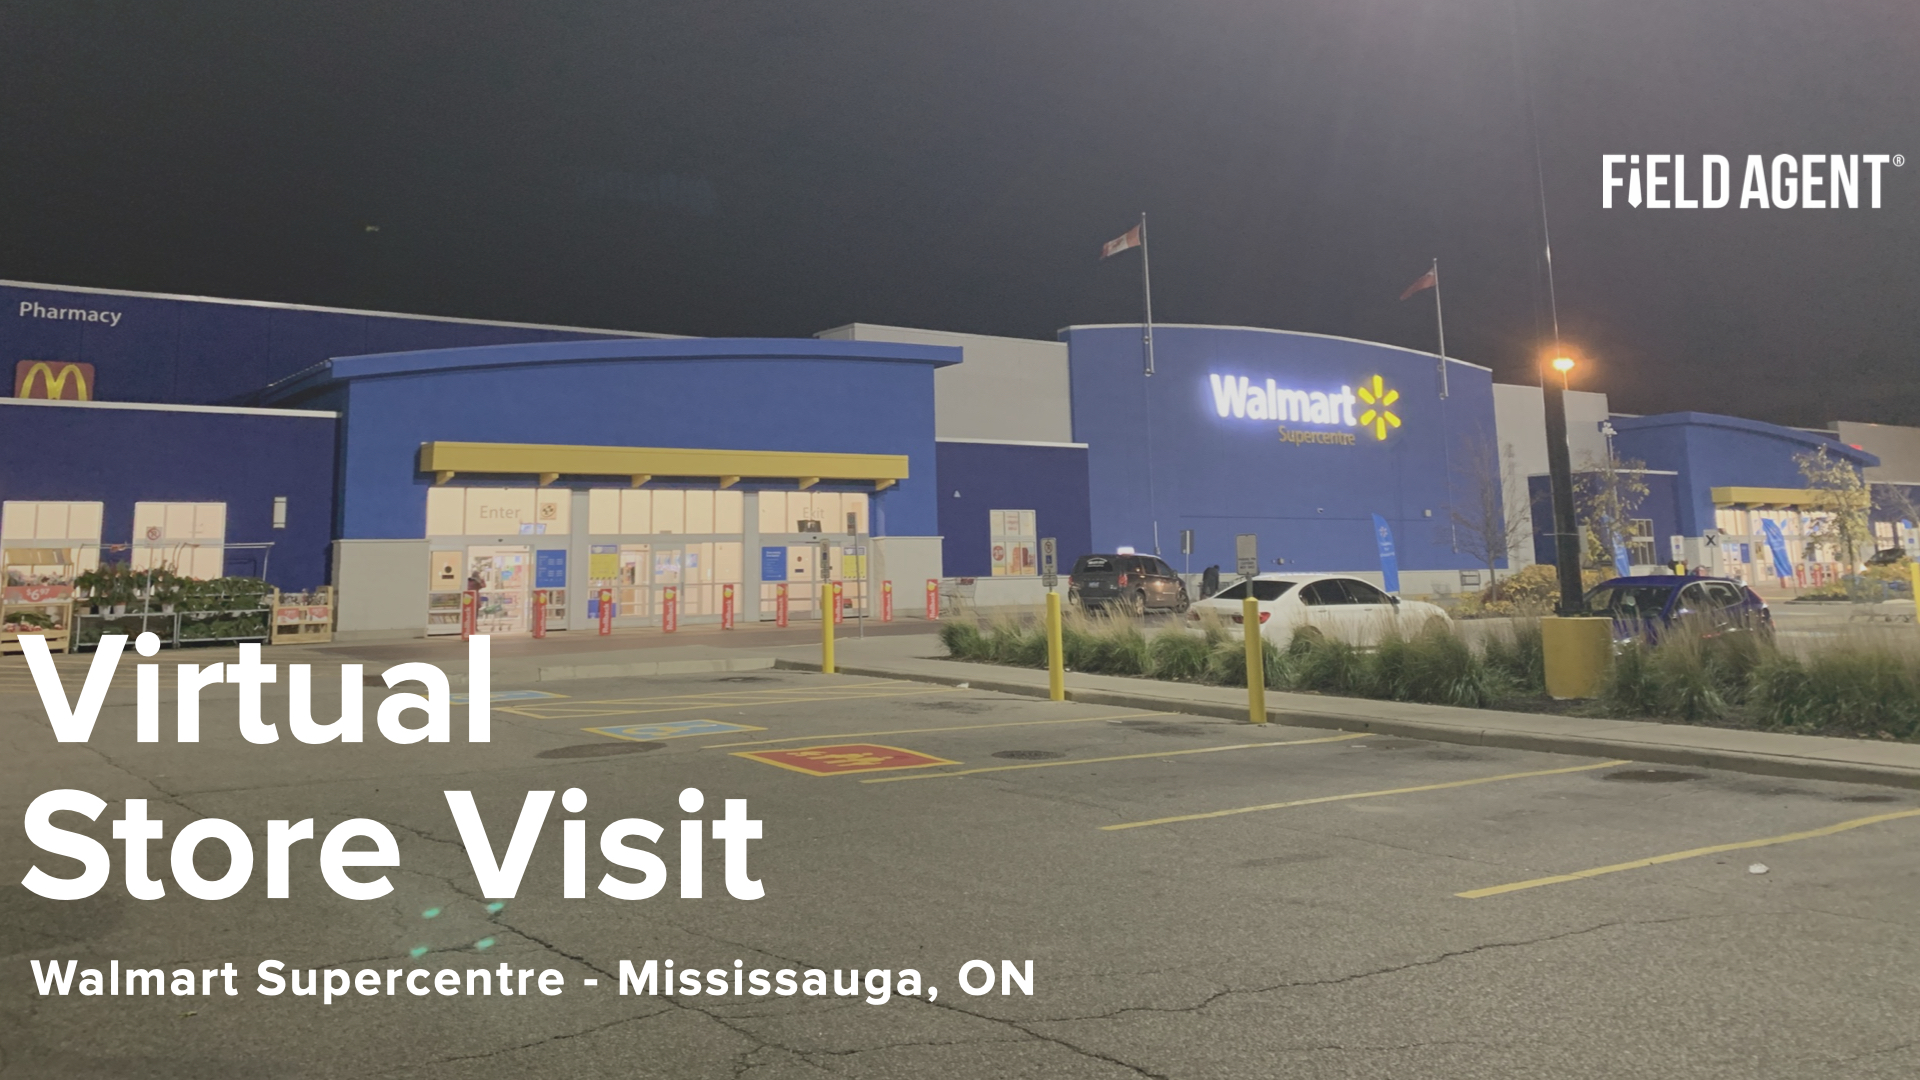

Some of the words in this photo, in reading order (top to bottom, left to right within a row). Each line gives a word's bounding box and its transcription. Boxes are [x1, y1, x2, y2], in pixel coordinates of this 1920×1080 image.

[19, 301, 122, 327] Pharmacy
[1209, 373, 1357, 426] Walmart
[1278, 425, 1356, 447] Supercentre
[480, 505, 522, 519] Enter
[802, 507, 825, 519] Exit
[602, 603, 610, 634] Rollback
[666, 601, 674, 631] Rollback
